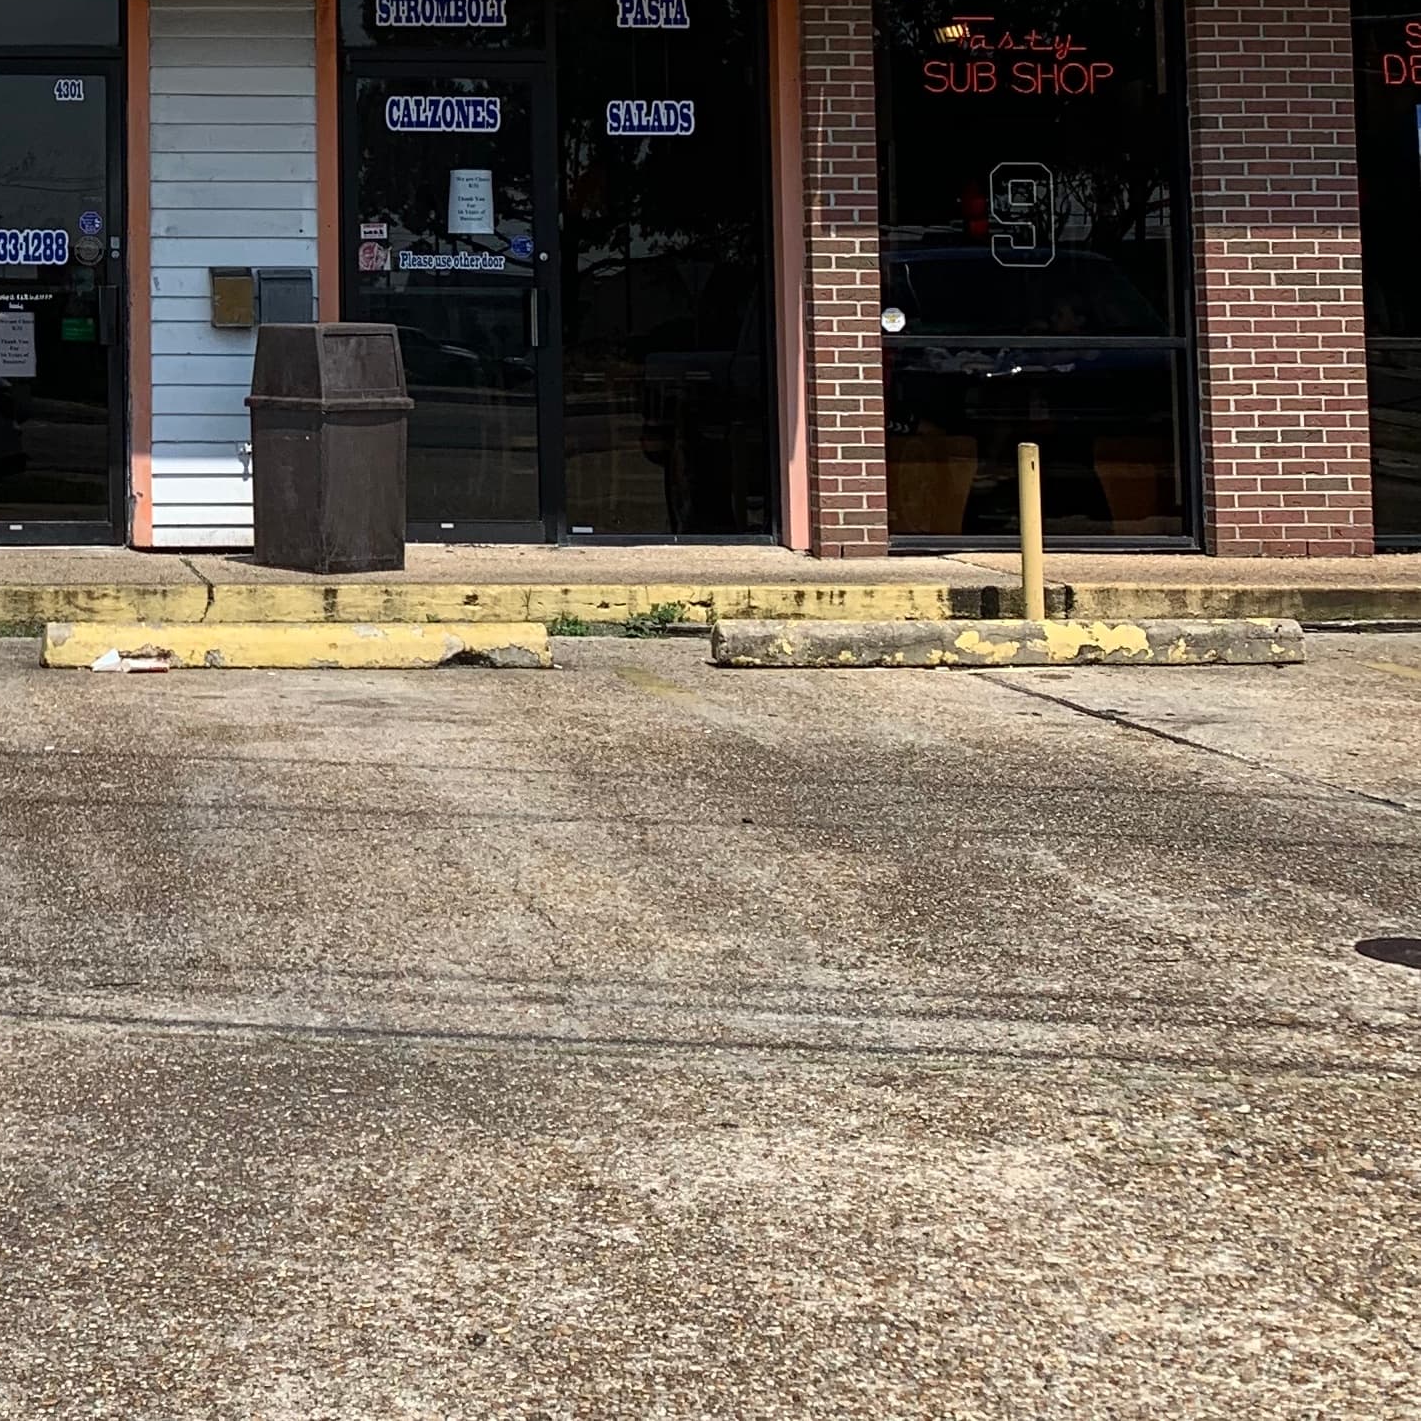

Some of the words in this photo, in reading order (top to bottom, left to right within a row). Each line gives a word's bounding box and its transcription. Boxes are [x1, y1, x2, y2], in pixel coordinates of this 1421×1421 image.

[54, 79, 84, 101] 4301
[924, 61, 996, 93] SUB
[1012, 61, 1114, 95] SHOP
[386, 96, 500, 131] CALZONES
[607, 100, 694, 135] SALADS
[989, 161, 1056, 268] 9
[399, 251, 434, 269] Please
[434, 256, 452, 270] use
[453, 251, 479, 270] other
[480, 251, 506, 270] door
